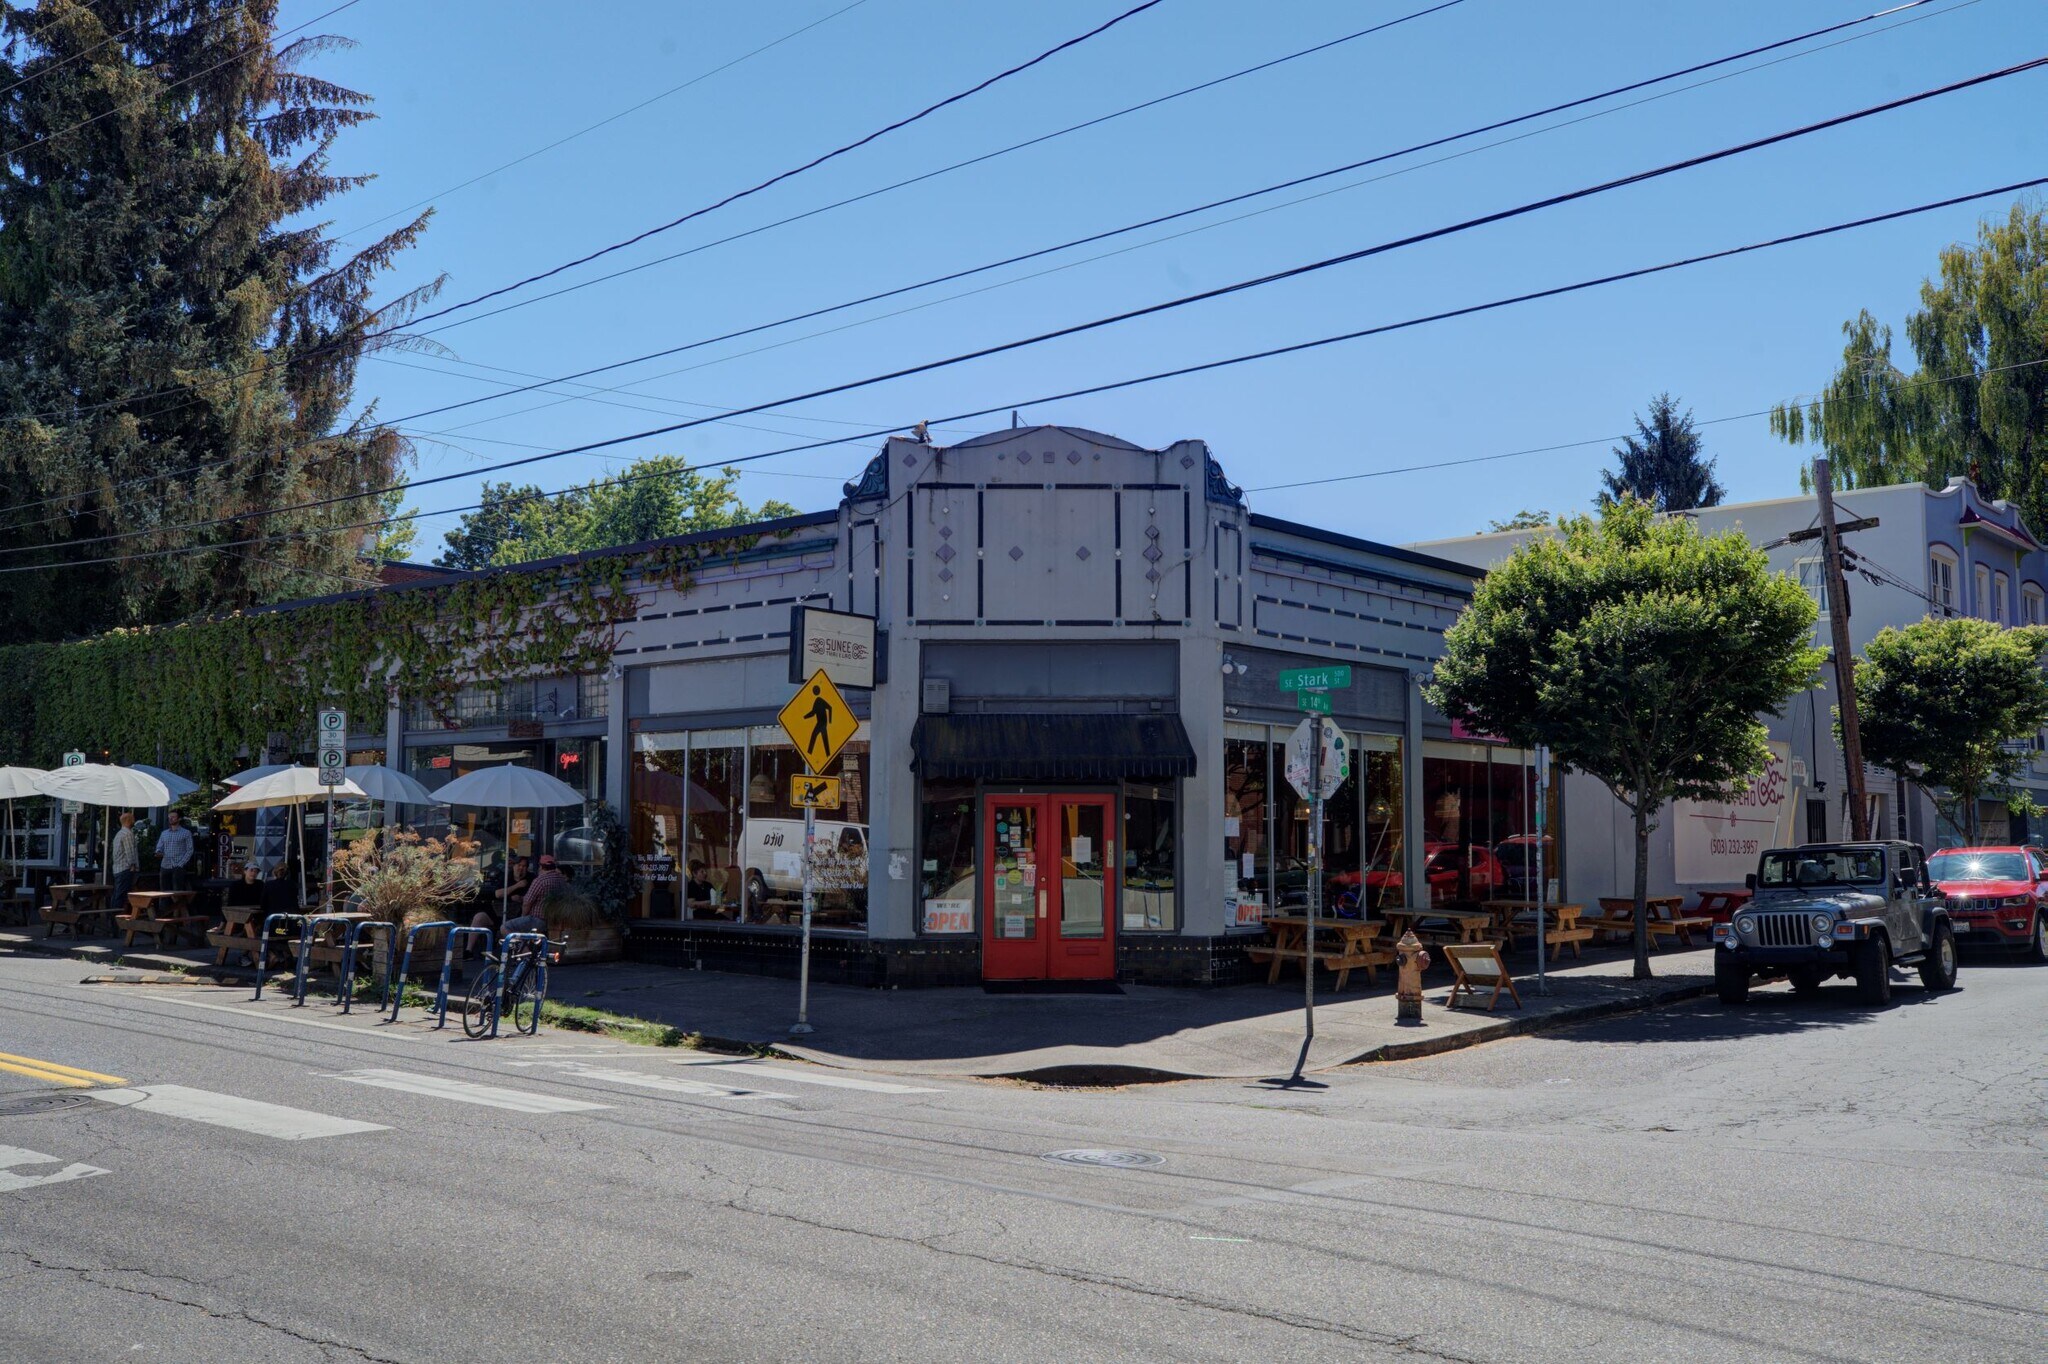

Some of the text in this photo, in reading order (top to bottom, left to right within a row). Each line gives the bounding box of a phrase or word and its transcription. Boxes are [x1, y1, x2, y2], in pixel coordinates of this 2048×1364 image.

[826, 639, 852, 653] SUNEE
[1285, 679, 1293, 688] SE
[1297, 672, 1329, 687] Stark
[560, 752, 579, 769] Open
[1710, 838, 1758, 855] (503) 232-3957
[928, 911, 969, 931] OPEN
[1238, 904, 1261, 922] OPEN
